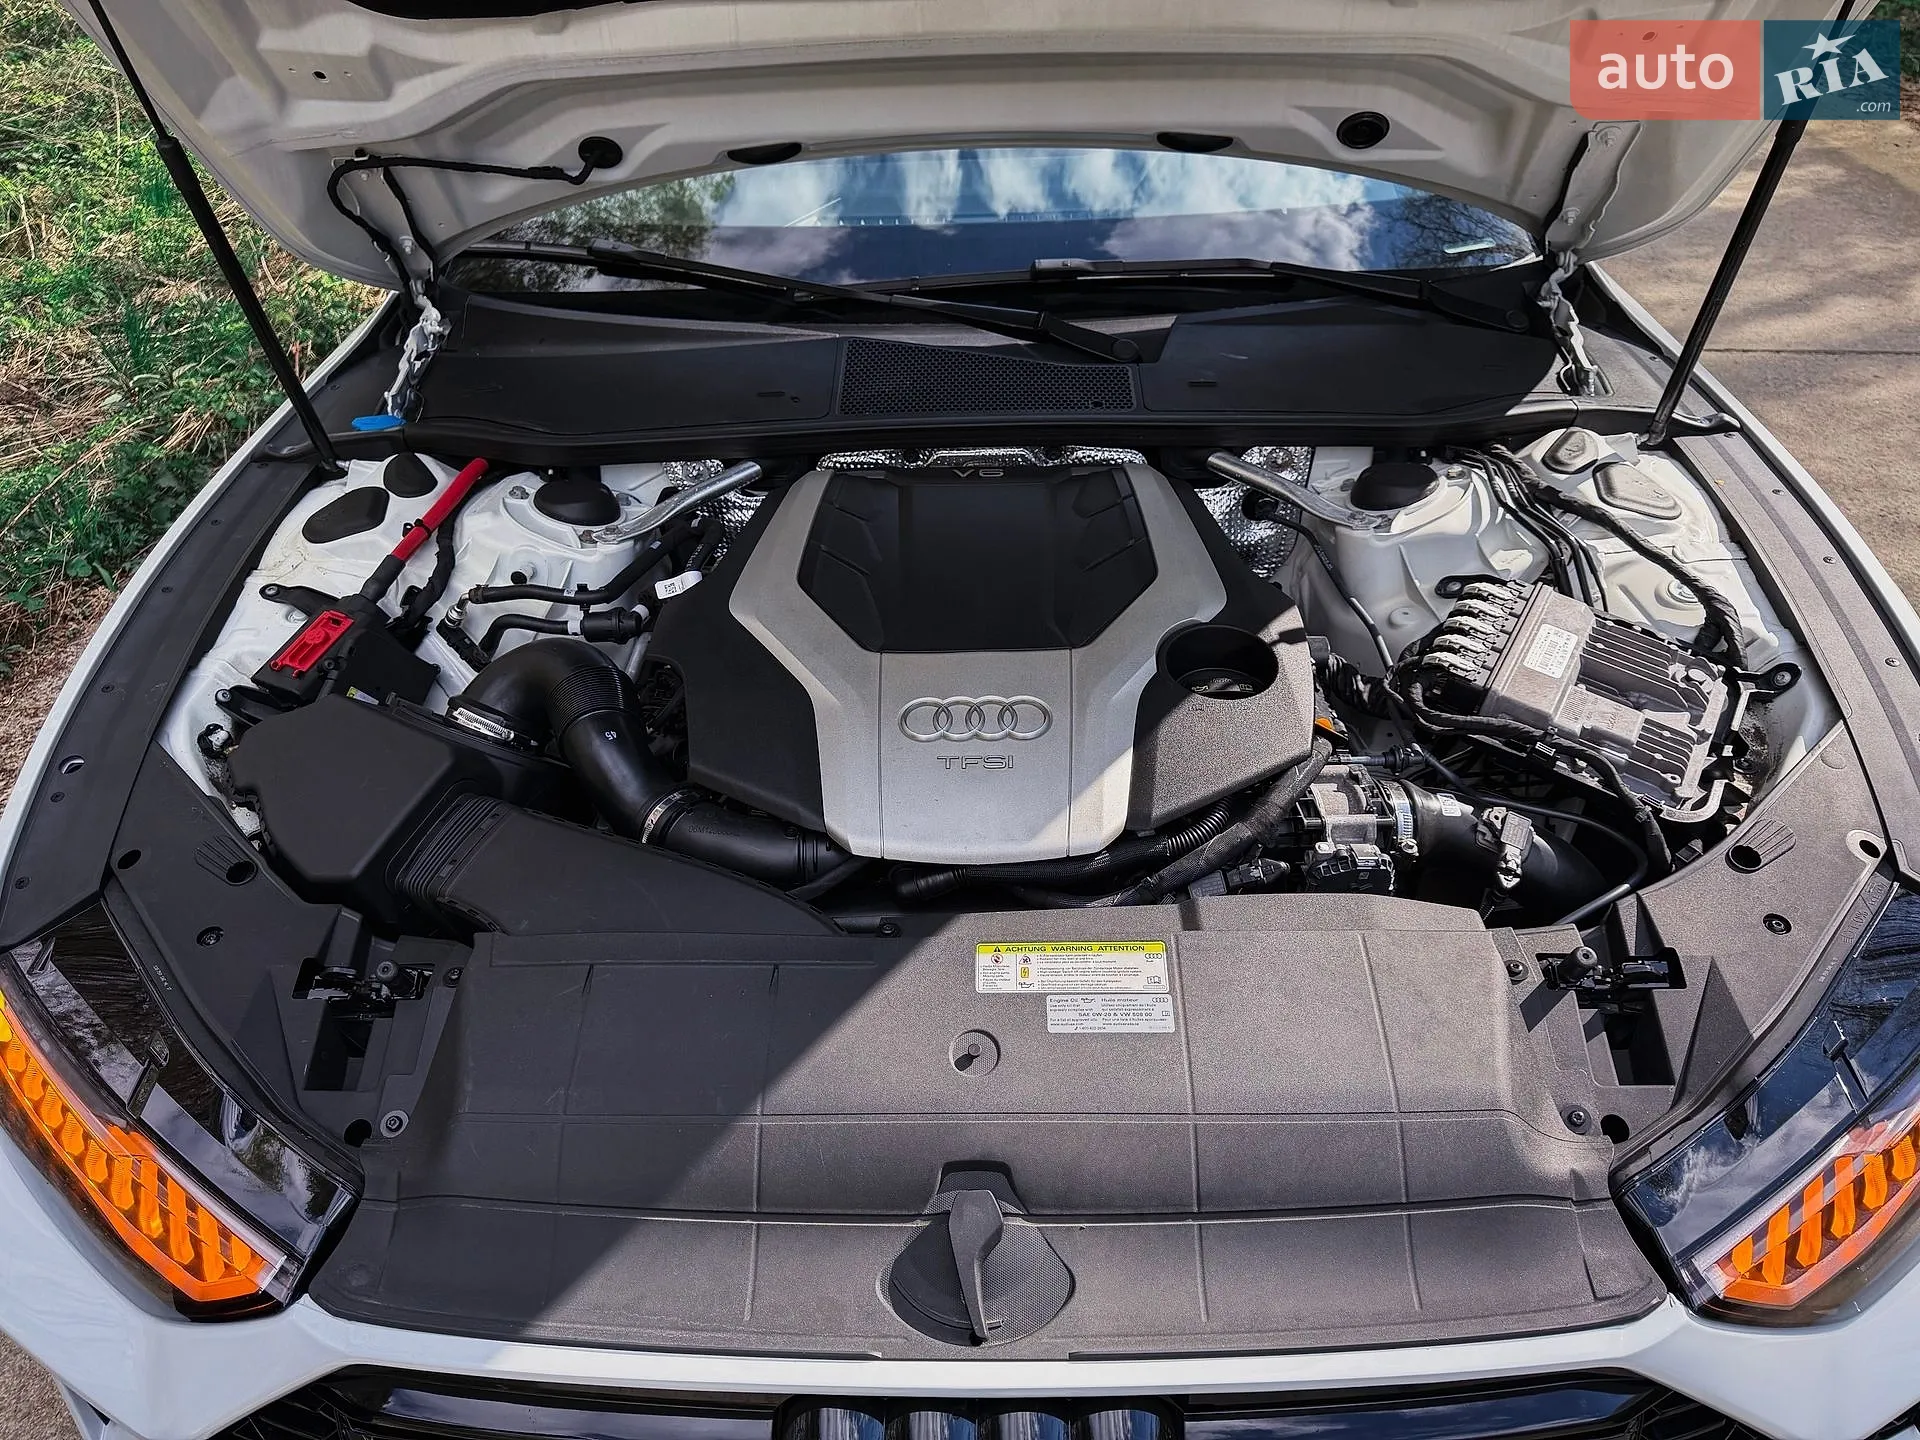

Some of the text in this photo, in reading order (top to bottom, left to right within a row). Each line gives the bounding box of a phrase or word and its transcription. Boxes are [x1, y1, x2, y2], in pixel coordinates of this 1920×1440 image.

[952, 468, 1004, 478] V6
[604, 730, 617, 741] 45
[936, 755, 1014, 770] TFSI
